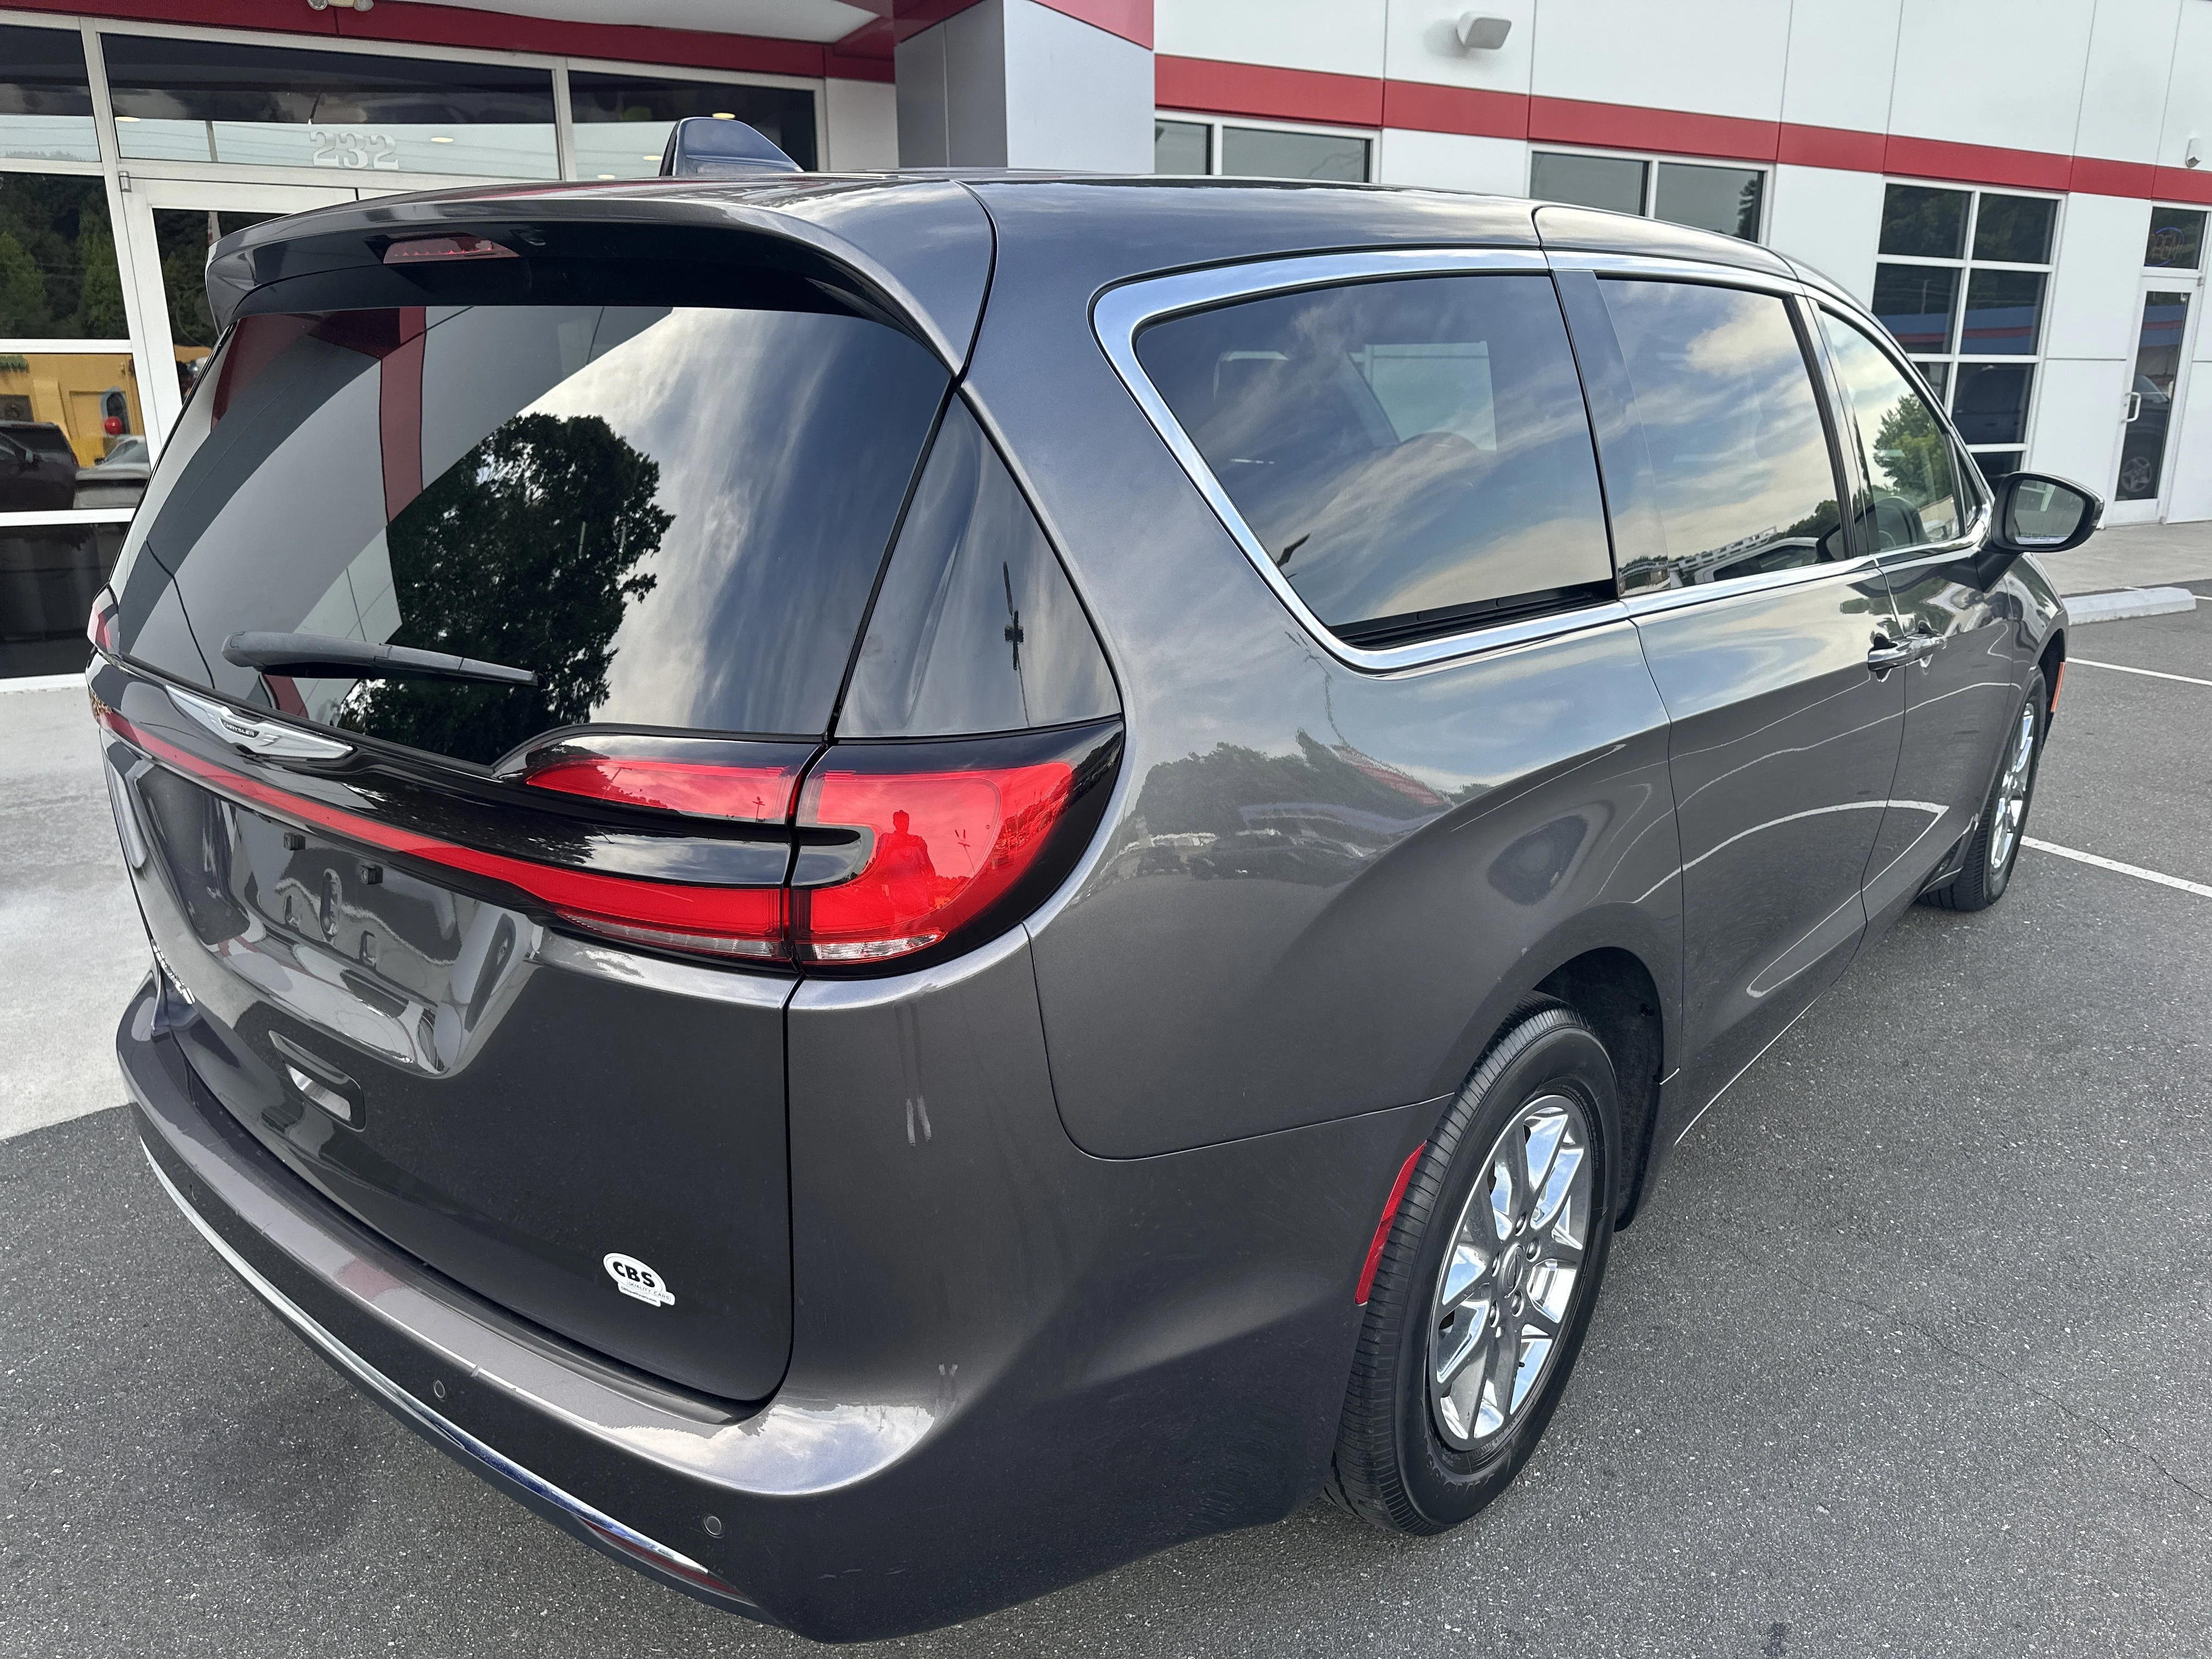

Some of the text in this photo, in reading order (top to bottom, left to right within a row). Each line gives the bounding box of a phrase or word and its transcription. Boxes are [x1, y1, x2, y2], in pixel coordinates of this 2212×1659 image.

[310, 131, 399, 170] 232
[223, 721, 255, 736] CHRYSLER
[613, 1261, 655, 1288] CBS
[628, 1282, 669, 1300] QUALITY CARS
